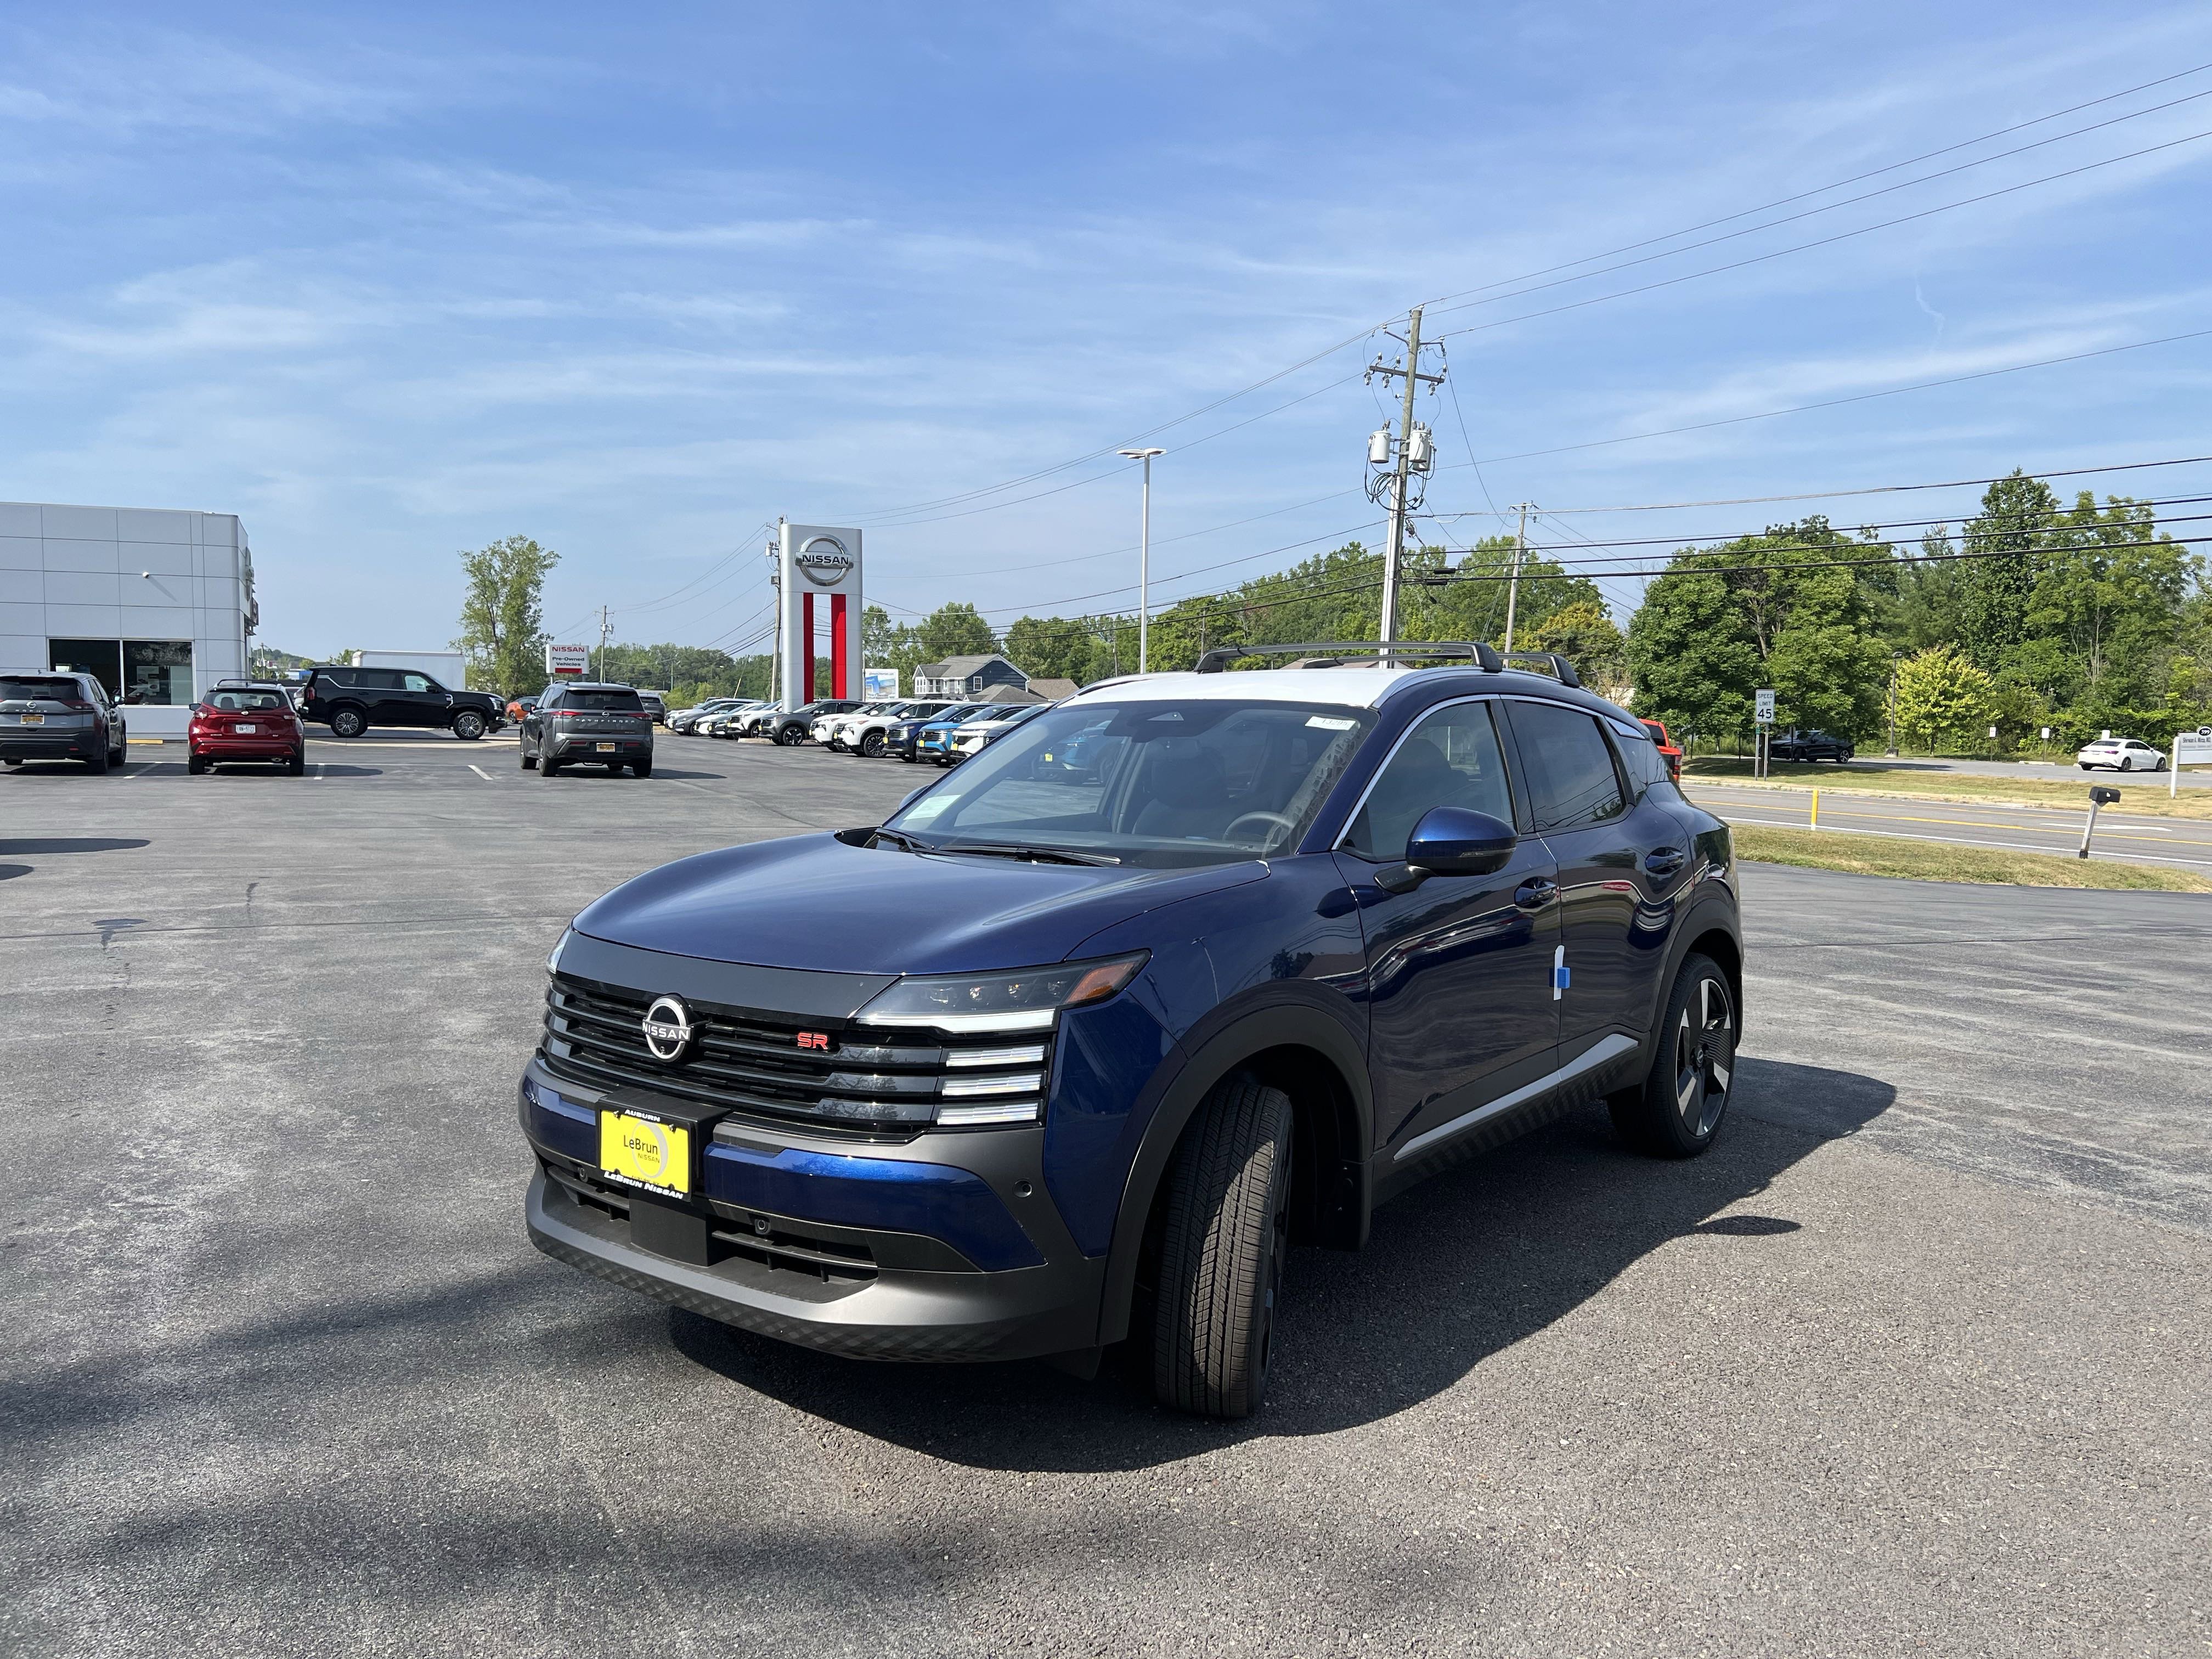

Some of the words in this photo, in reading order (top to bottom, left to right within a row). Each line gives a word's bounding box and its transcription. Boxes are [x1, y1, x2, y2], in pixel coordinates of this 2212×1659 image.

[802, 555, 849, 565] NISSAN
[1758, 709, 1771, 719] 45
[642, 1022, 689, 1040] NISSAN
[798, 1032, 828, 1050] SR
[624, 1109, 661, 1122] AUBURN
[623, 1135, 658, 1155] LeBrun
[638, 1153, 660, 1164] NISSAN
[644, 1183, 684, 1199] NISSAN
